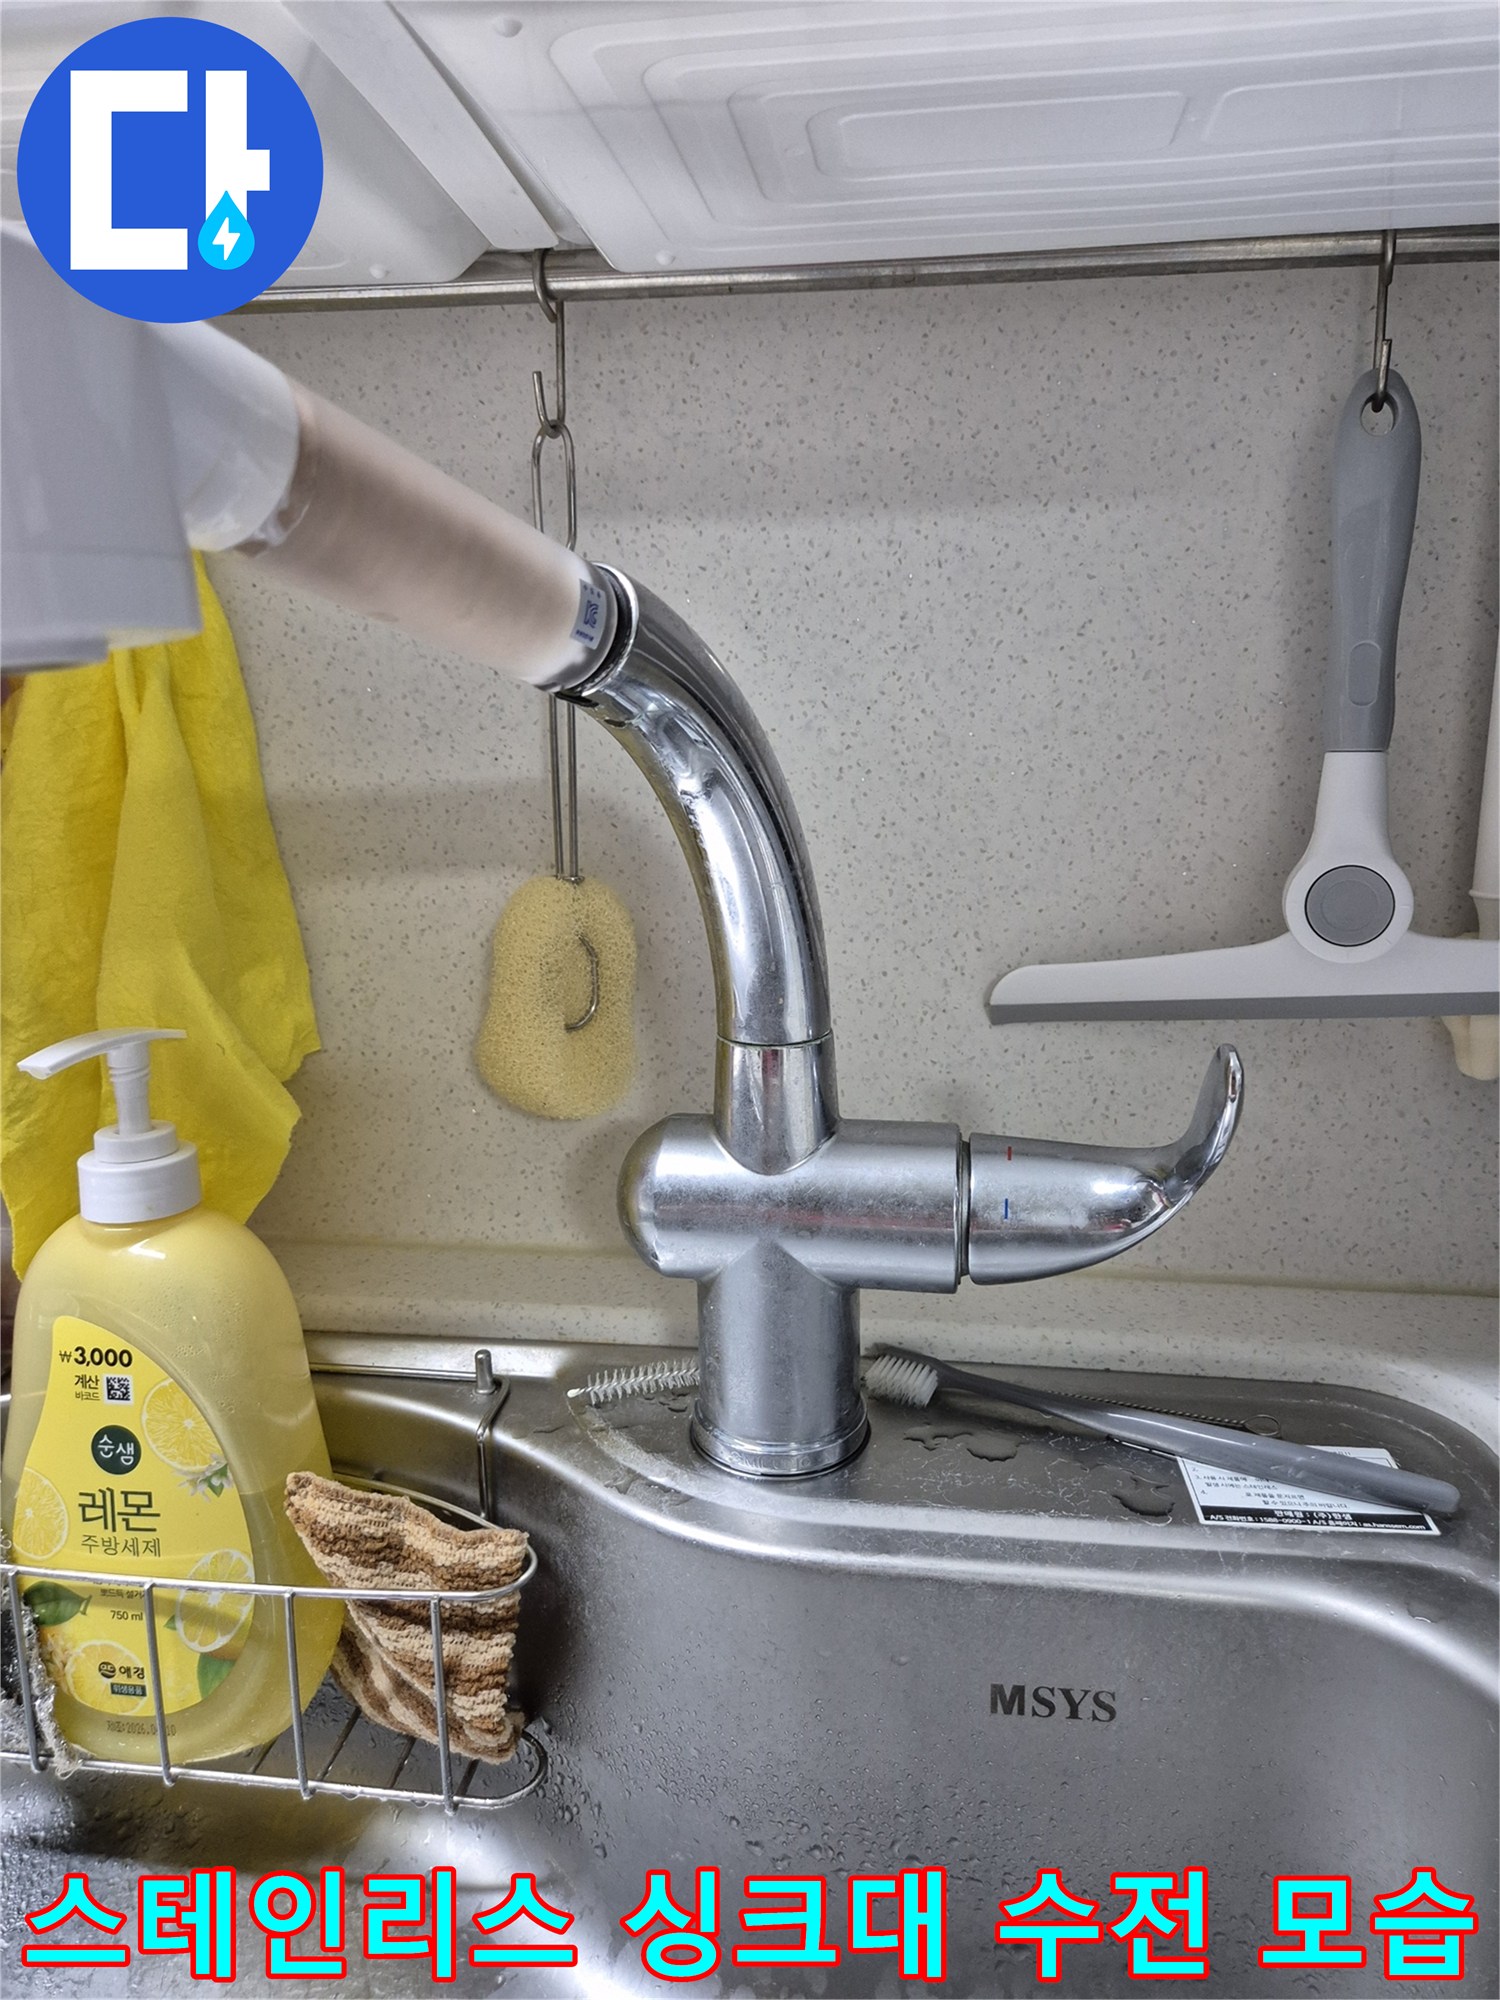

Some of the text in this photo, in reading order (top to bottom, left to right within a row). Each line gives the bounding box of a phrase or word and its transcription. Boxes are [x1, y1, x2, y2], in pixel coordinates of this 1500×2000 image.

[74, 1374, 100, 1390] 계산
[74, 1391, 101, 1401] 바코드
[97, 1434, 135, 1466] 순샘
[78, 1487, 161, 1533] 레몬
[81, 1534, 161, 1557] 주방세제
[110, 1609, 144, 1622] 750 ml
[118, 1665, 145, 1680] 애경
[990, 1683, 1117, 1723] MSYS
